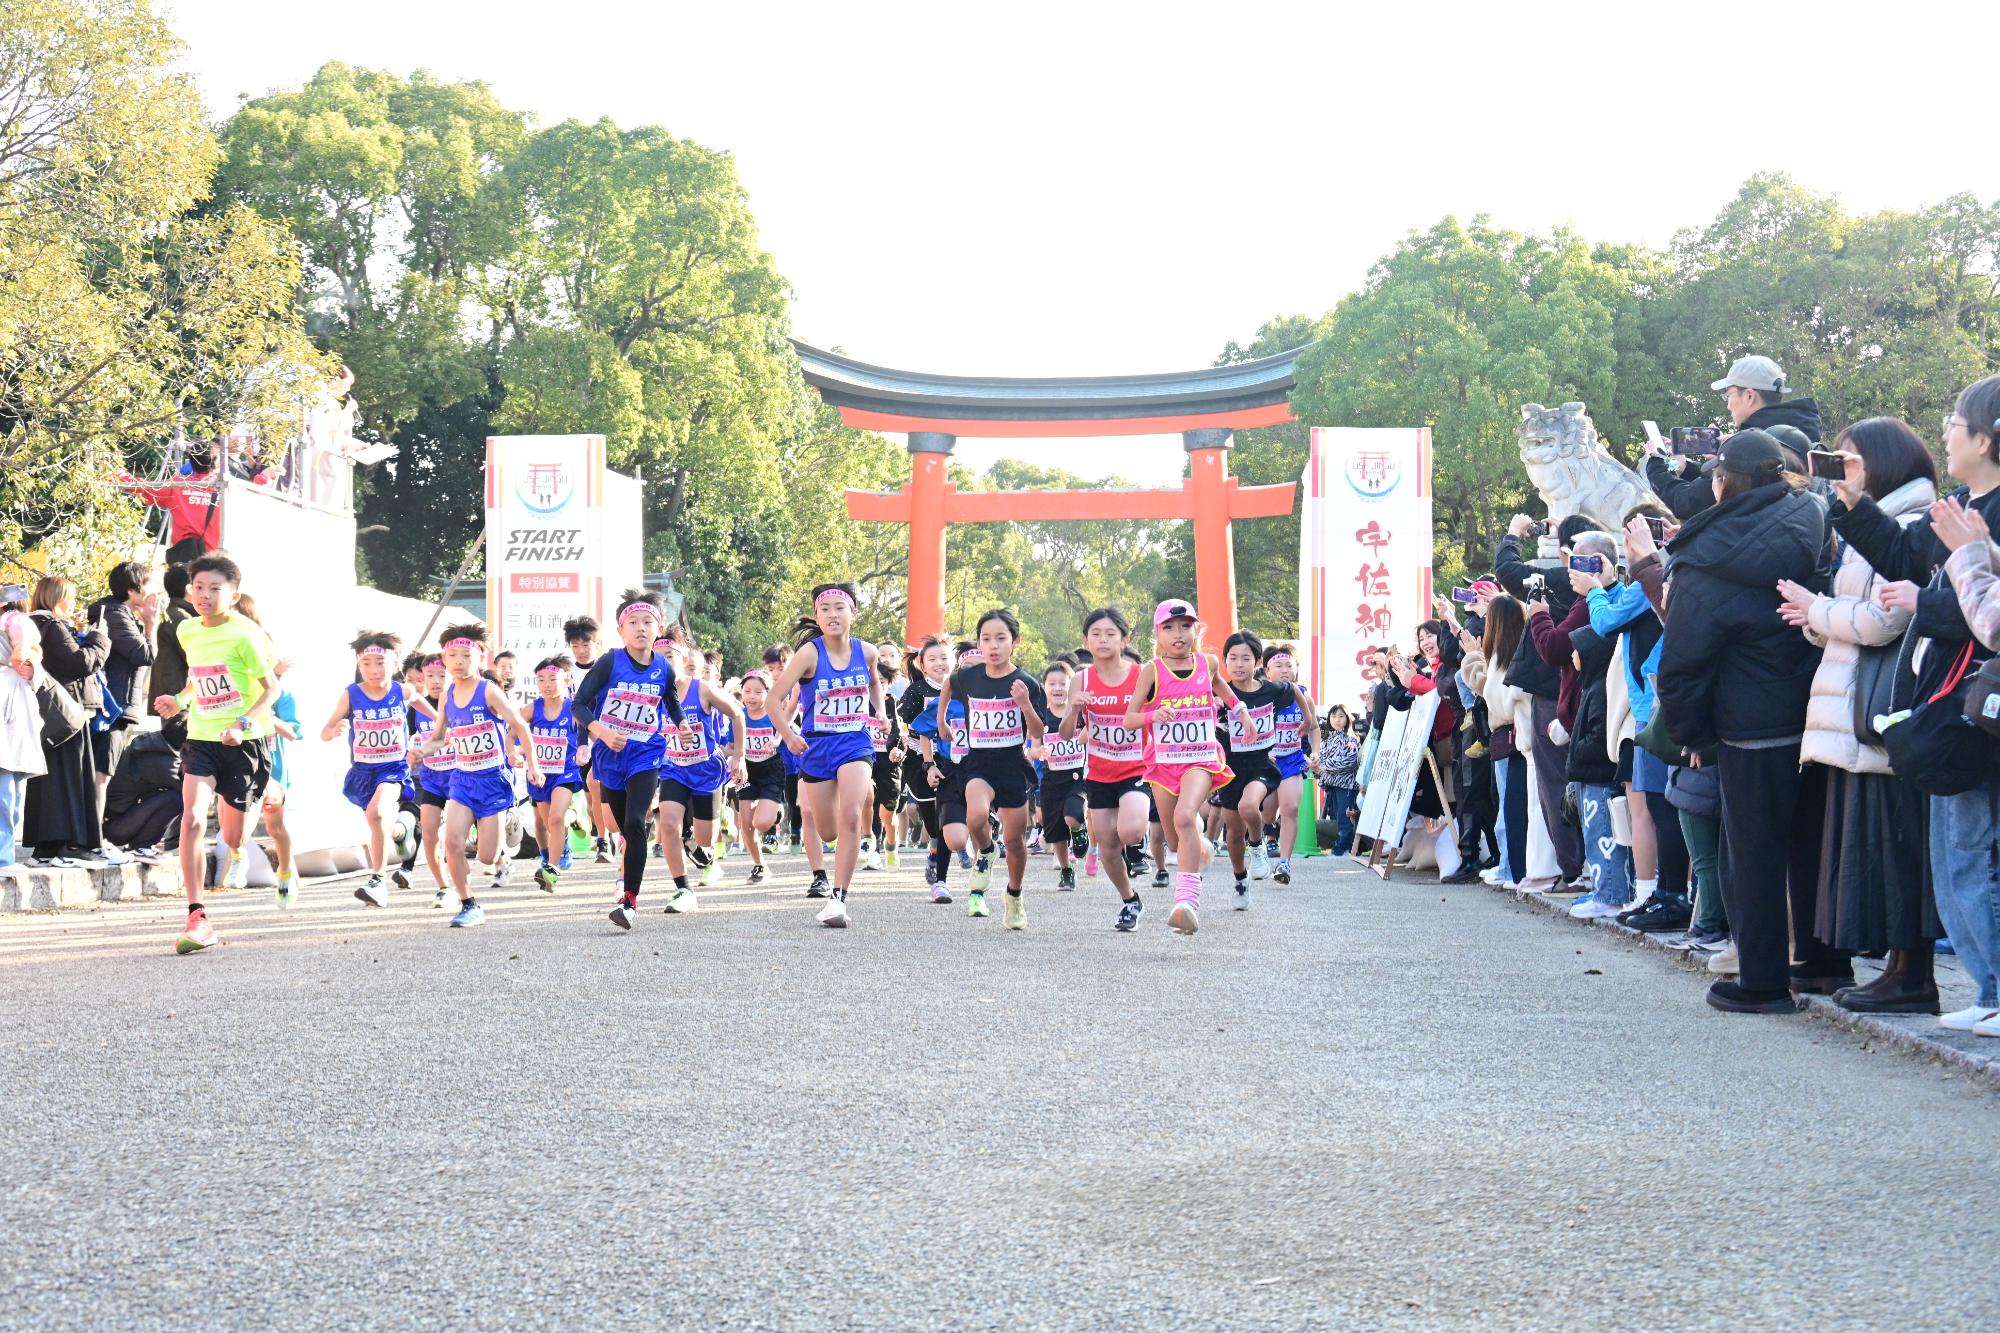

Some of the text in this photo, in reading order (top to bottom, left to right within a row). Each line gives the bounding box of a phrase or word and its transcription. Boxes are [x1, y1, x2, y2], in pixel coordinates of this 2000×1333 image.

[507, 529, 582, 544] START
[504, 546, 585, 562] FINISH
[518, 576, 571, 590] 特別協賛
[1355, 520, 1392, 703] 宇佐神宮
[818, 674, 866, 690] 豊後高田
[819, 695, 865, 716] 2112
[1160, 694, 1209, 709] ランギャル
[607, 699, 655, 725] 2113
[972, 710, 1017, 730] 2128
[1092, 724, 1137, 745] 2103
[1159, 721, 1208, 744] 2001
[1234, 715, 1271, 737] 227
[358, 729, 399, 748] 2002
[1048, 739, 1083, 757] 2036
